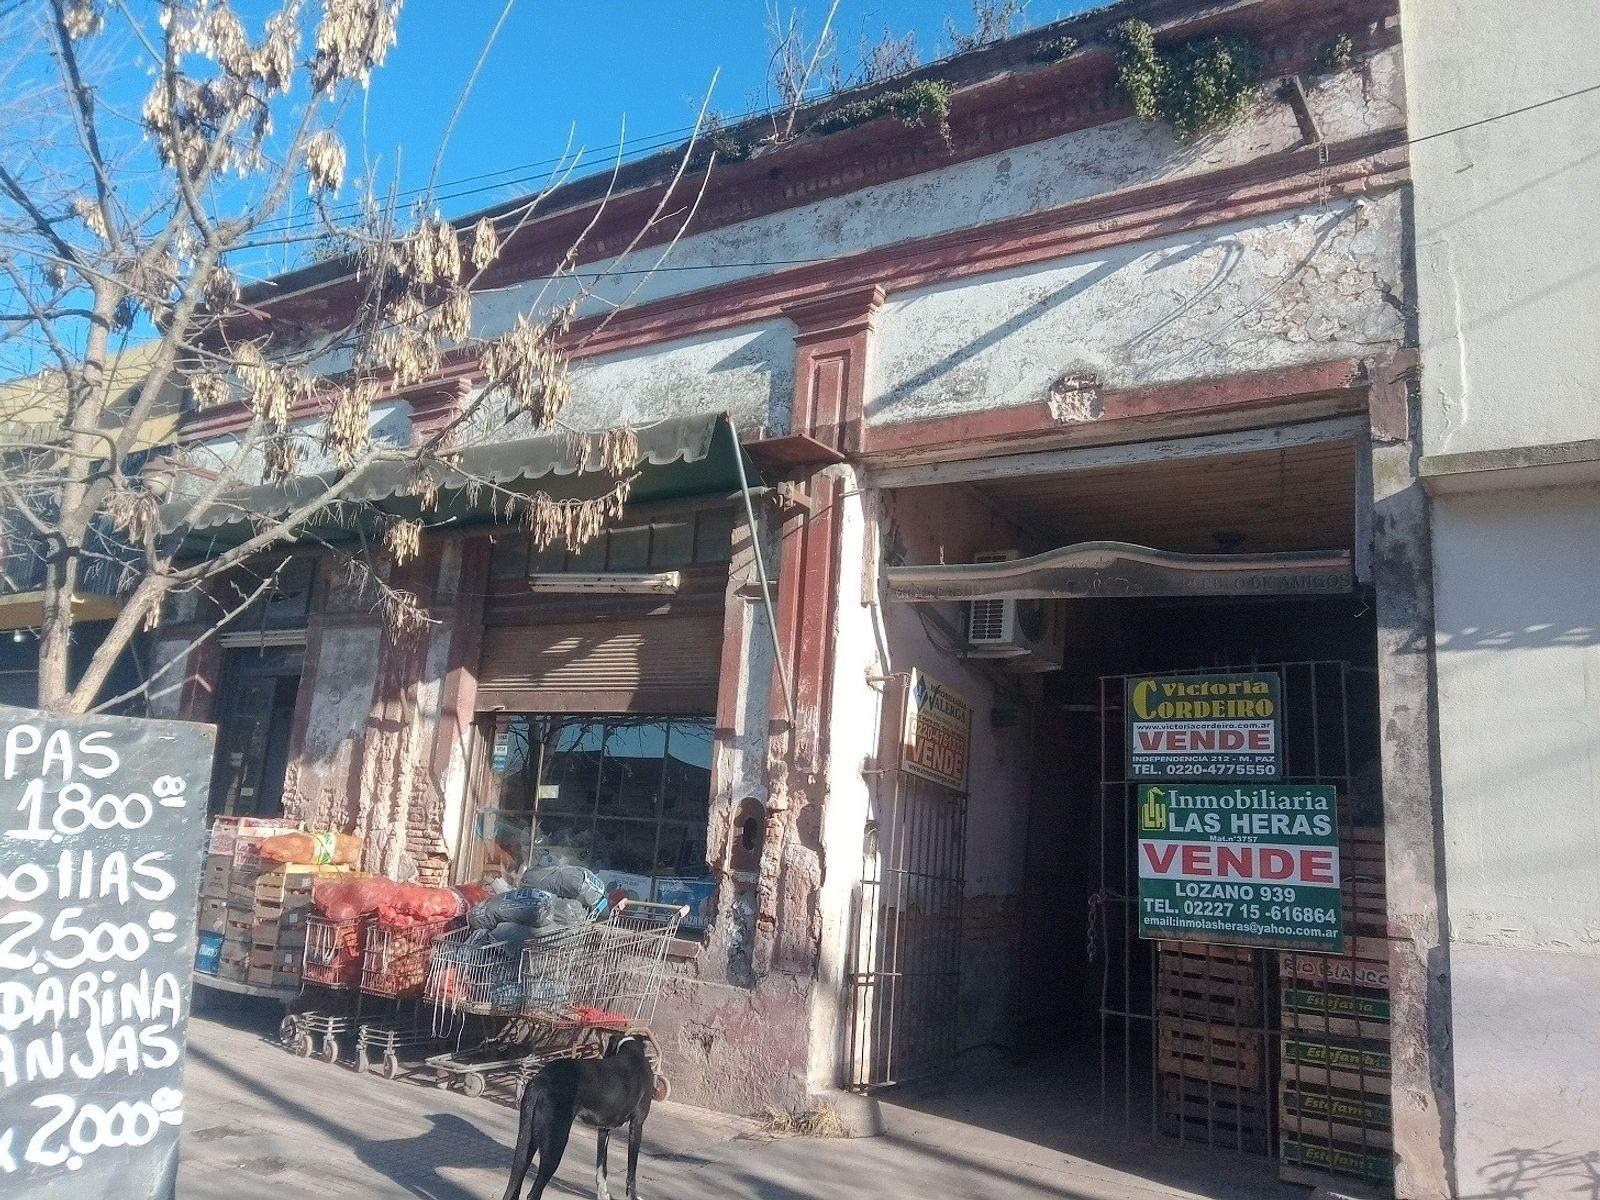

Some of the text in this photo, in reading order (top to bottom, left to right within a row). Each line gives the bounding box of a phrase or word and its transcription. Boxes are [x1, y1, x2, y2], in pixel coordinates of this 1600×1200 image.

[1132, 678, 1275, 720] CORDEIRO
[1161, 680, 1269, 697] Victoria
[1136, 722, 1271, 730] www.victoriacordeiro.com.ar
[1137, 730, 1271, 751] VENDE
[4, 724, 120, 783] PAS
[912, 739, 963, 781] VENDE
[1132, 755, 1209, 763] INDEPENDENCIA
[1210, 755, 1231, 763] 212
[1239, 755, 1252, 763] M.
[1255, 755, 1275, 763] PAZ
[1132, 763, 1276, 776] TEL. 0220-4775550
[1168, 789, 1329, 811] Inmobiliaria
[1168, 812, 1332, 837] LAS HERAS
[1142, 843, 1334, 884] VENDE
[1175, 882, 1296, 903] LOZANO 939
[1143, 898, 1179, 914] TEL.
[1183, 900, 1234, 917] 02227
[1239, 904, 1260, 919] 15
[1143, 916, 1339, 938] email:inmolasheras@yahoo.com.ar
[1306, 1047, 1375, 1066] Estefana
